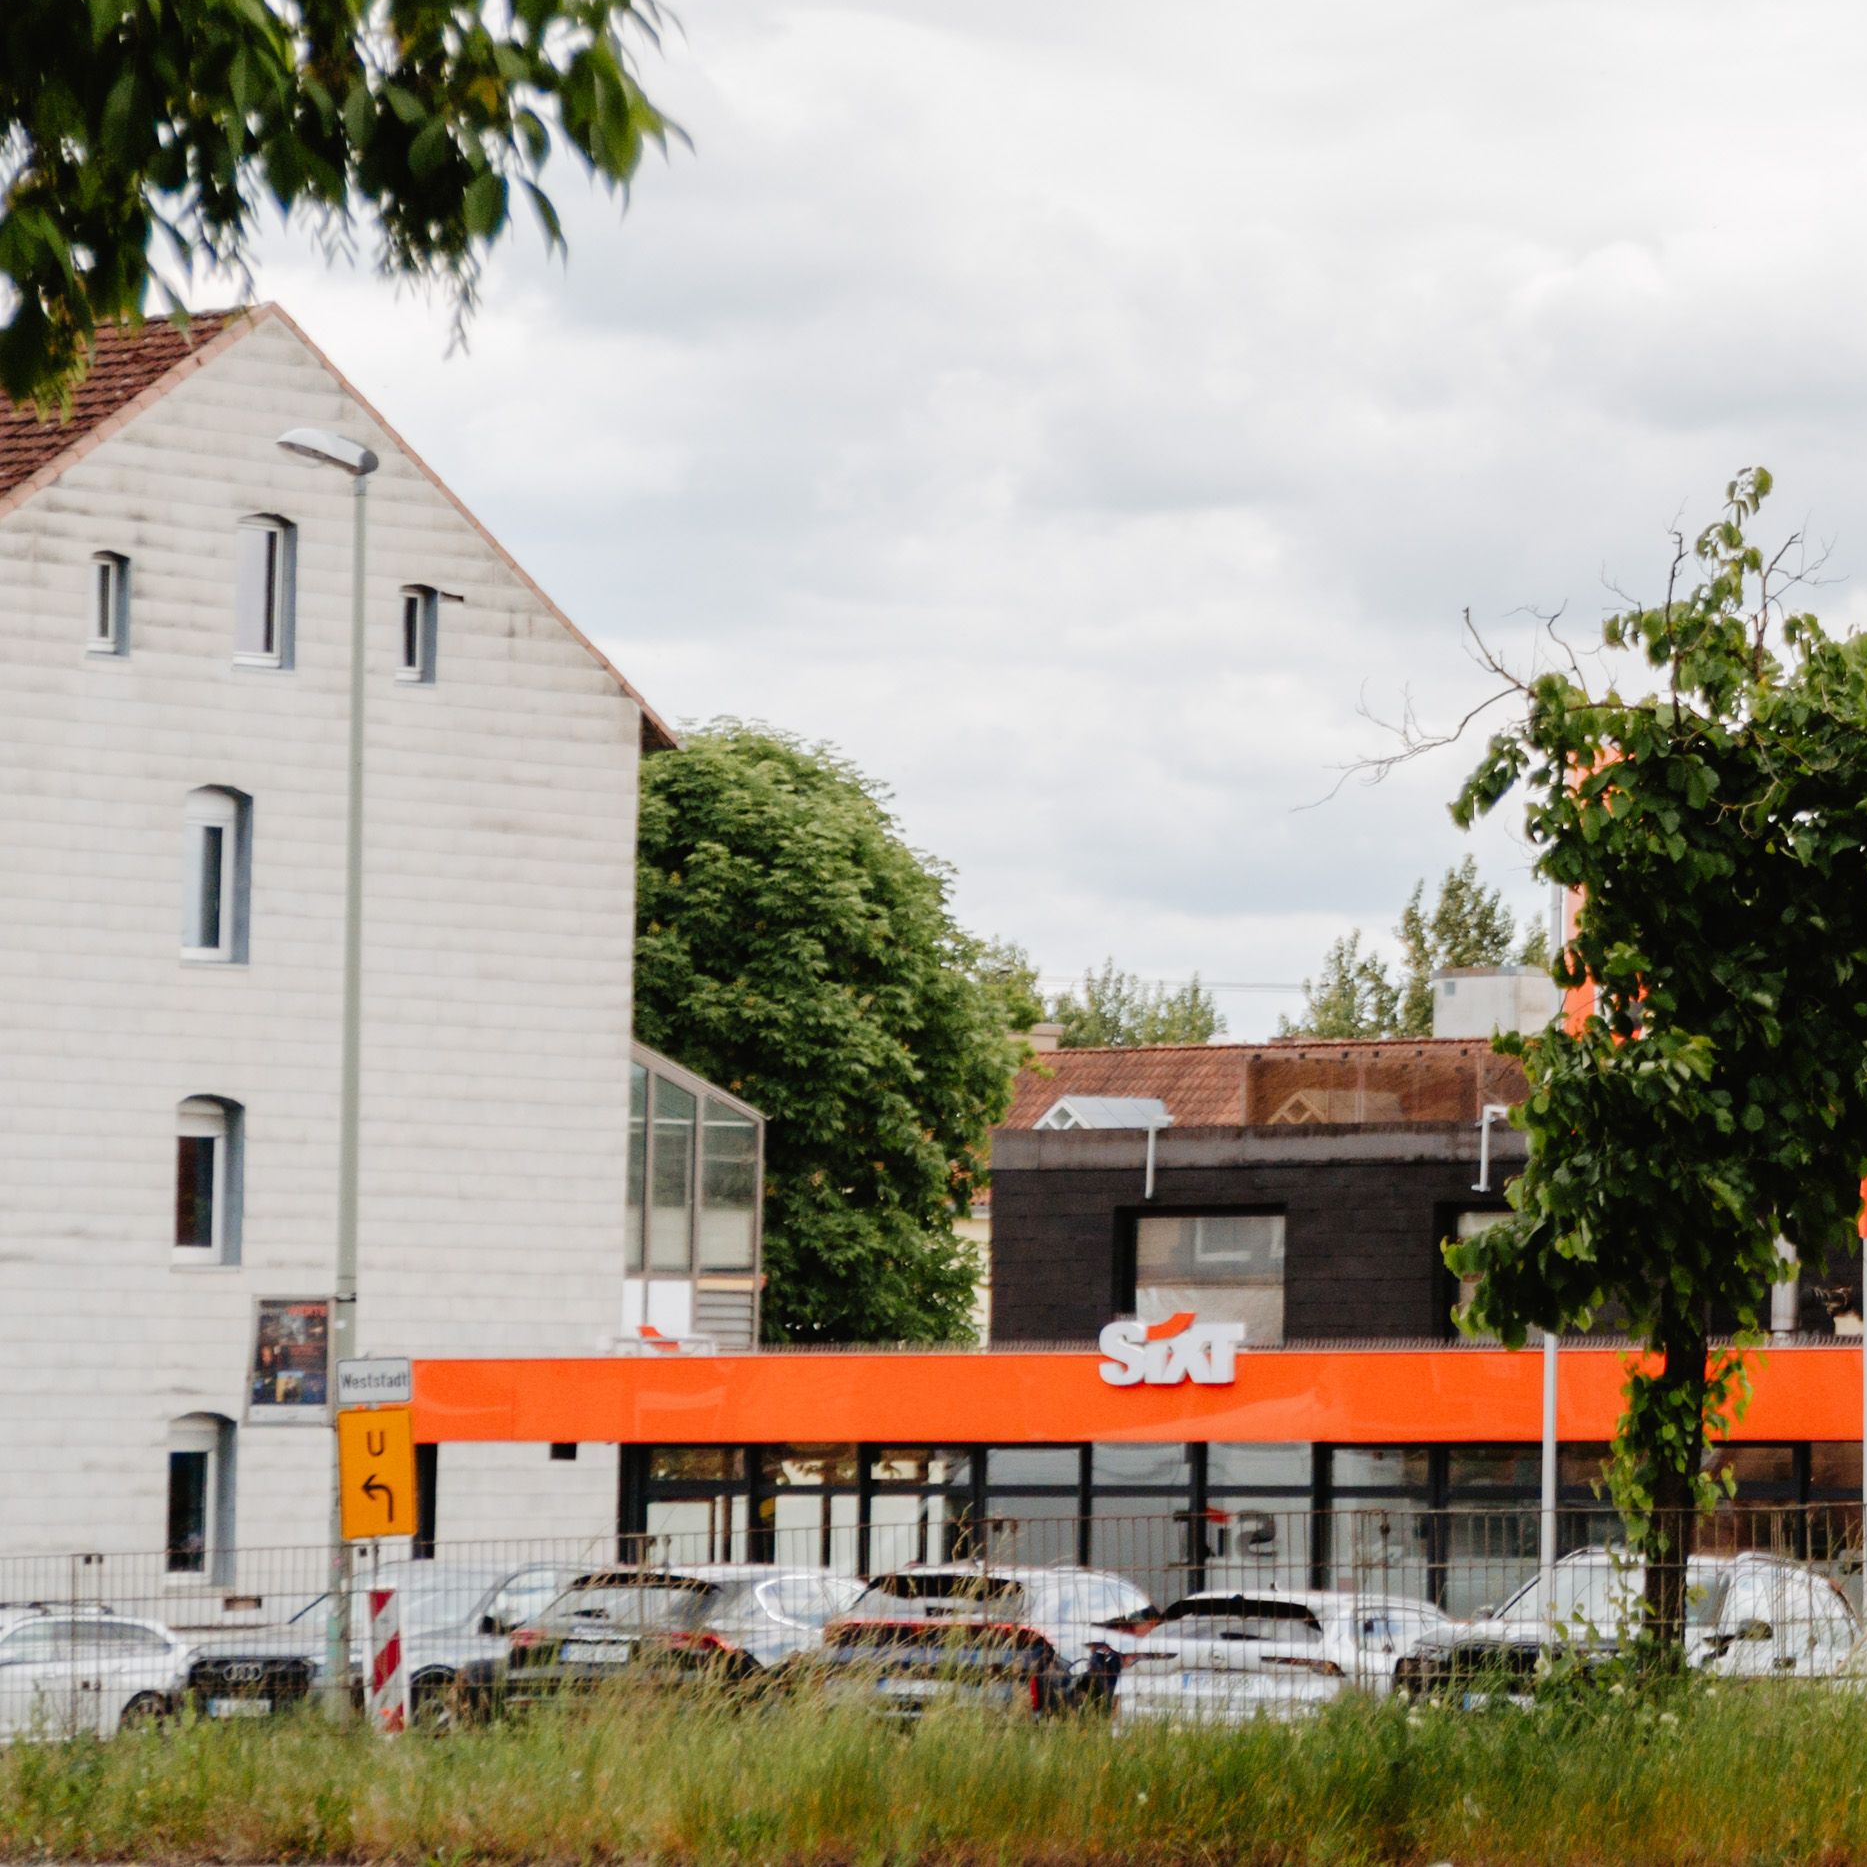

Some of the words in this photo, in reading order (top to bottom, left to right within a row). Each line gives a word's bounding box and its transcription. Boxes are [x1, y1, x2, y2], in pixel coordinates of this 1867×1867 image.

[1098, 1314, 1245, 1386] SIXT
[342, 1373, 408, 1389] Weststadt
[366, 1430, 385, 1457] U
